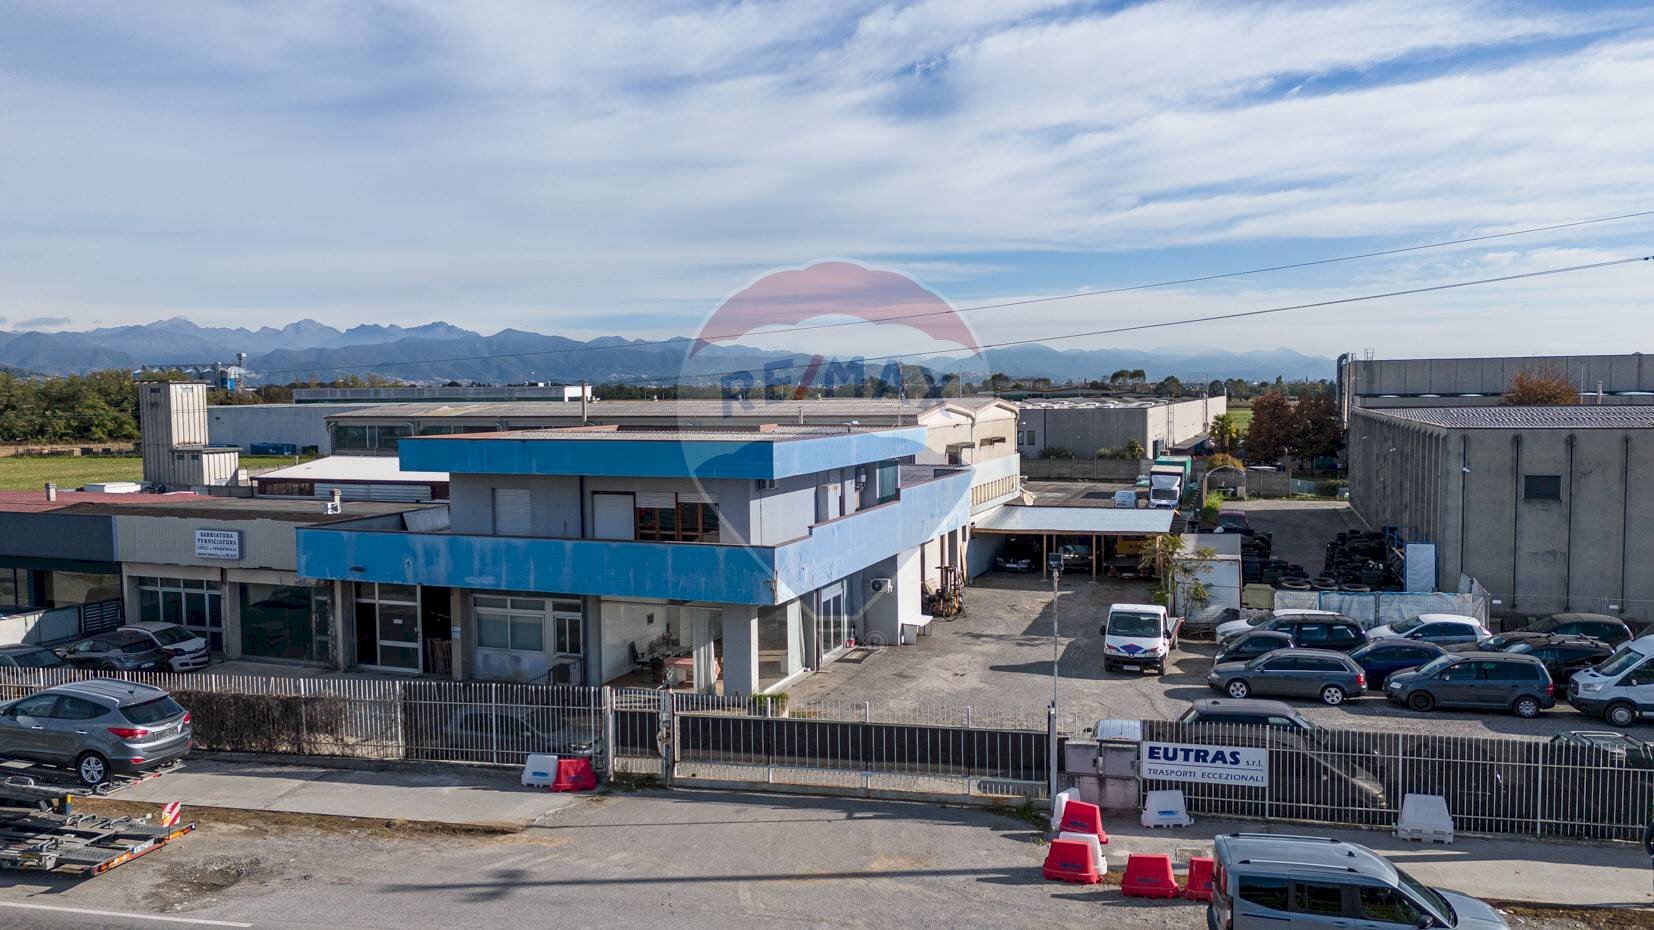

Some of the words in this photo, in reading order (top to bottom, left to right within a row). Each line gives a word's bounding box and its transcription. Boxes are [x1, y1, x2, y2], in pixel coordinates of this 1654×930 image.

[197, 538, 237, 546] VERNICIATURA
[1148, 746, 1240, 766] EUTRAS
[1245, 759, 1263, 767] s.r.l.
[1147, 768, 1196, 778] TRASPORTI
[1201, 772, 1264, 783] ECCEZIONALI
